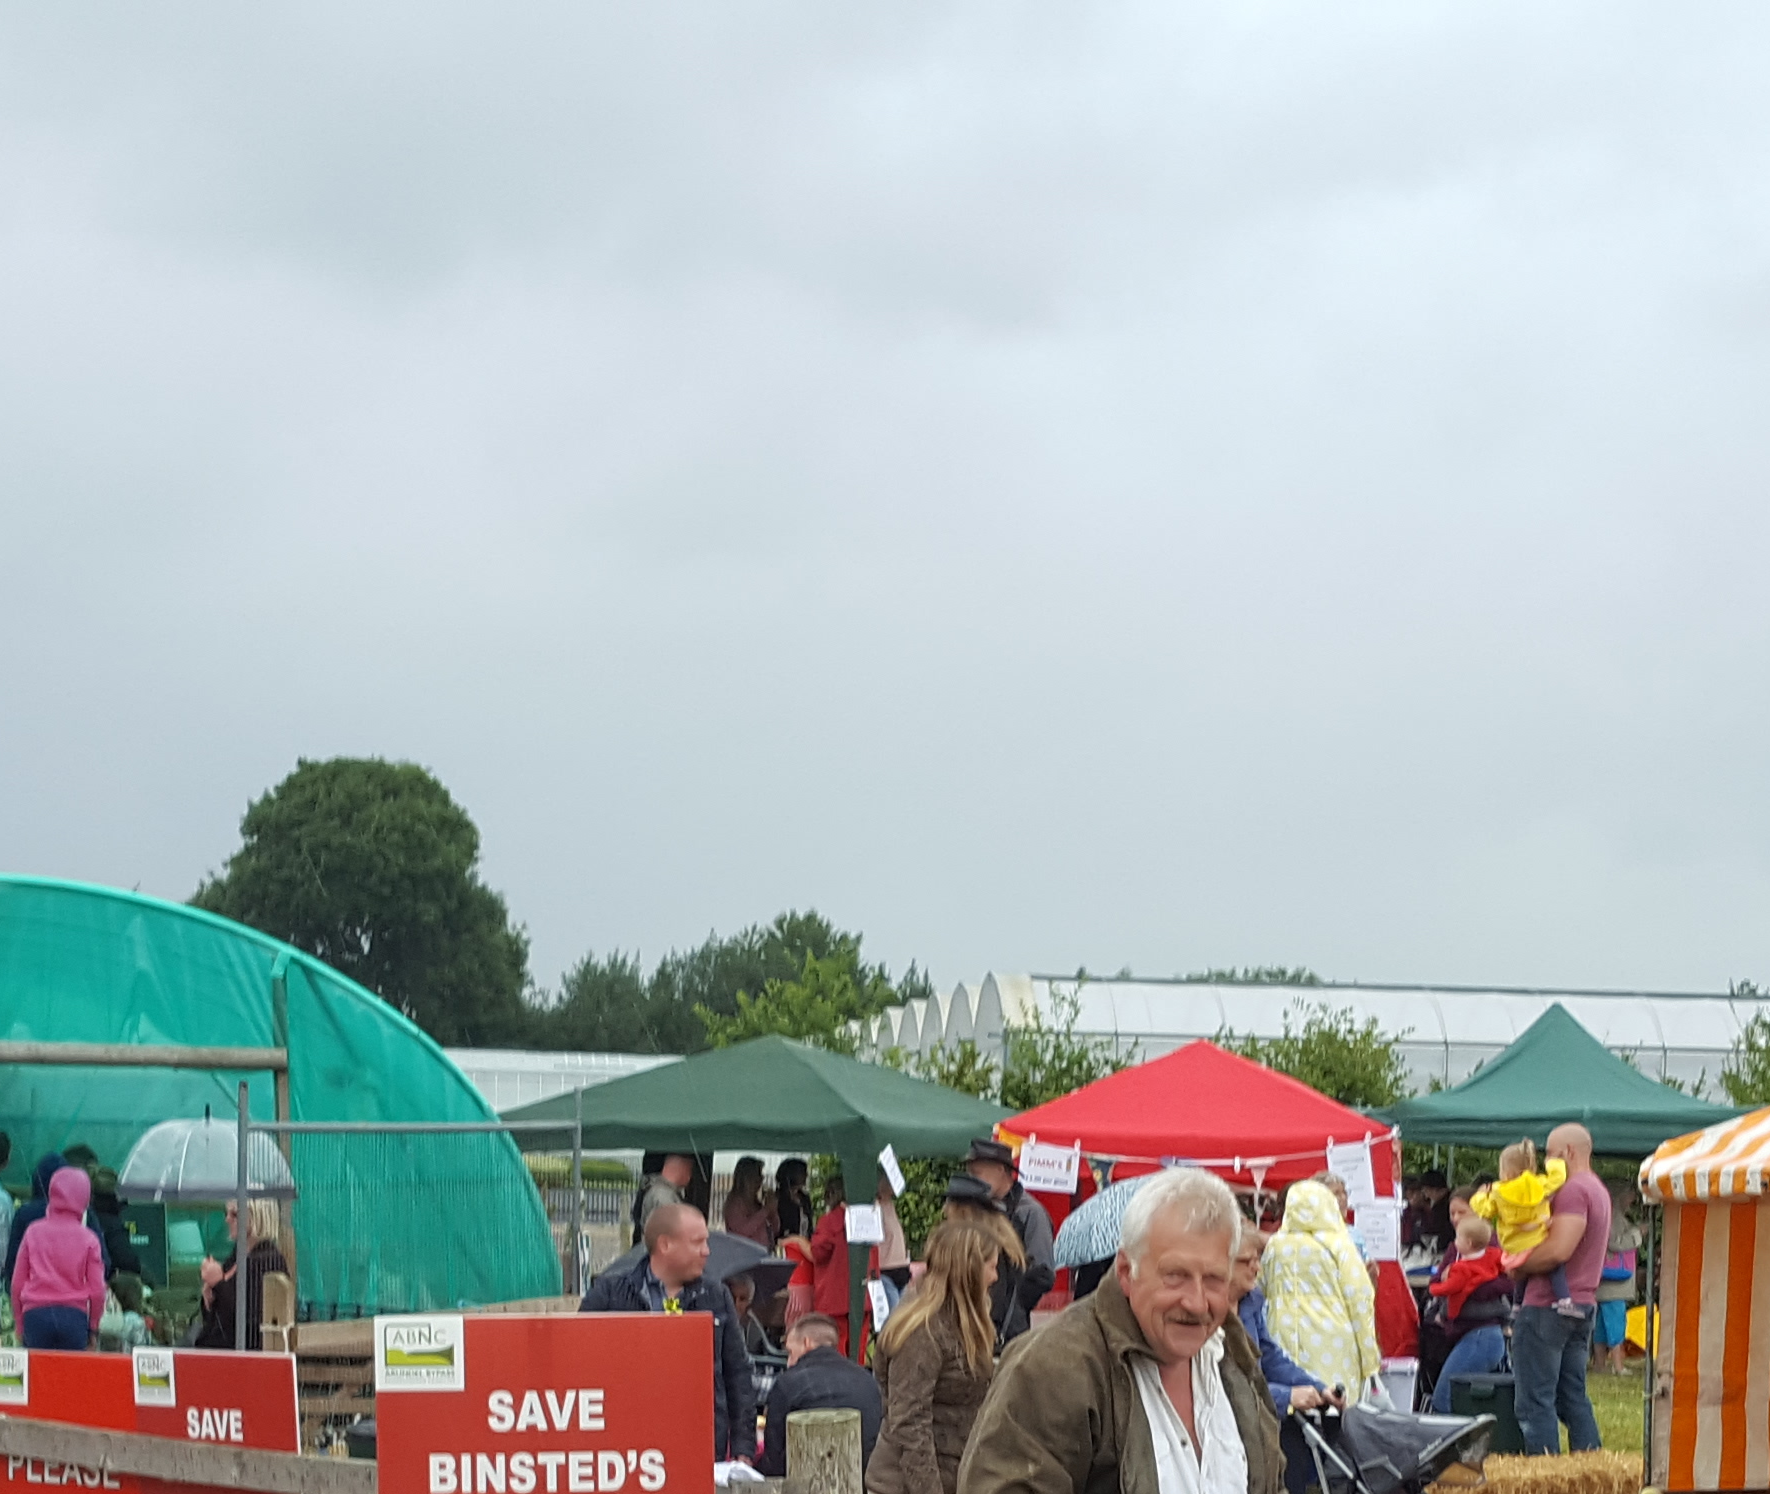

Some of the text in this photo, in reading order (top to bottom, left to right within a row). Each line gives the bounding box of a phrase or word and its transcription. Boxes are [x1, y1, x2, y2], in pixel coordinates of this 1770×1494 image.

[392, 1328, 447, 1346] ABNC
[186, 1407, 244, 1443] SAVE
[487, 1388, 606, 1433] SAVE
